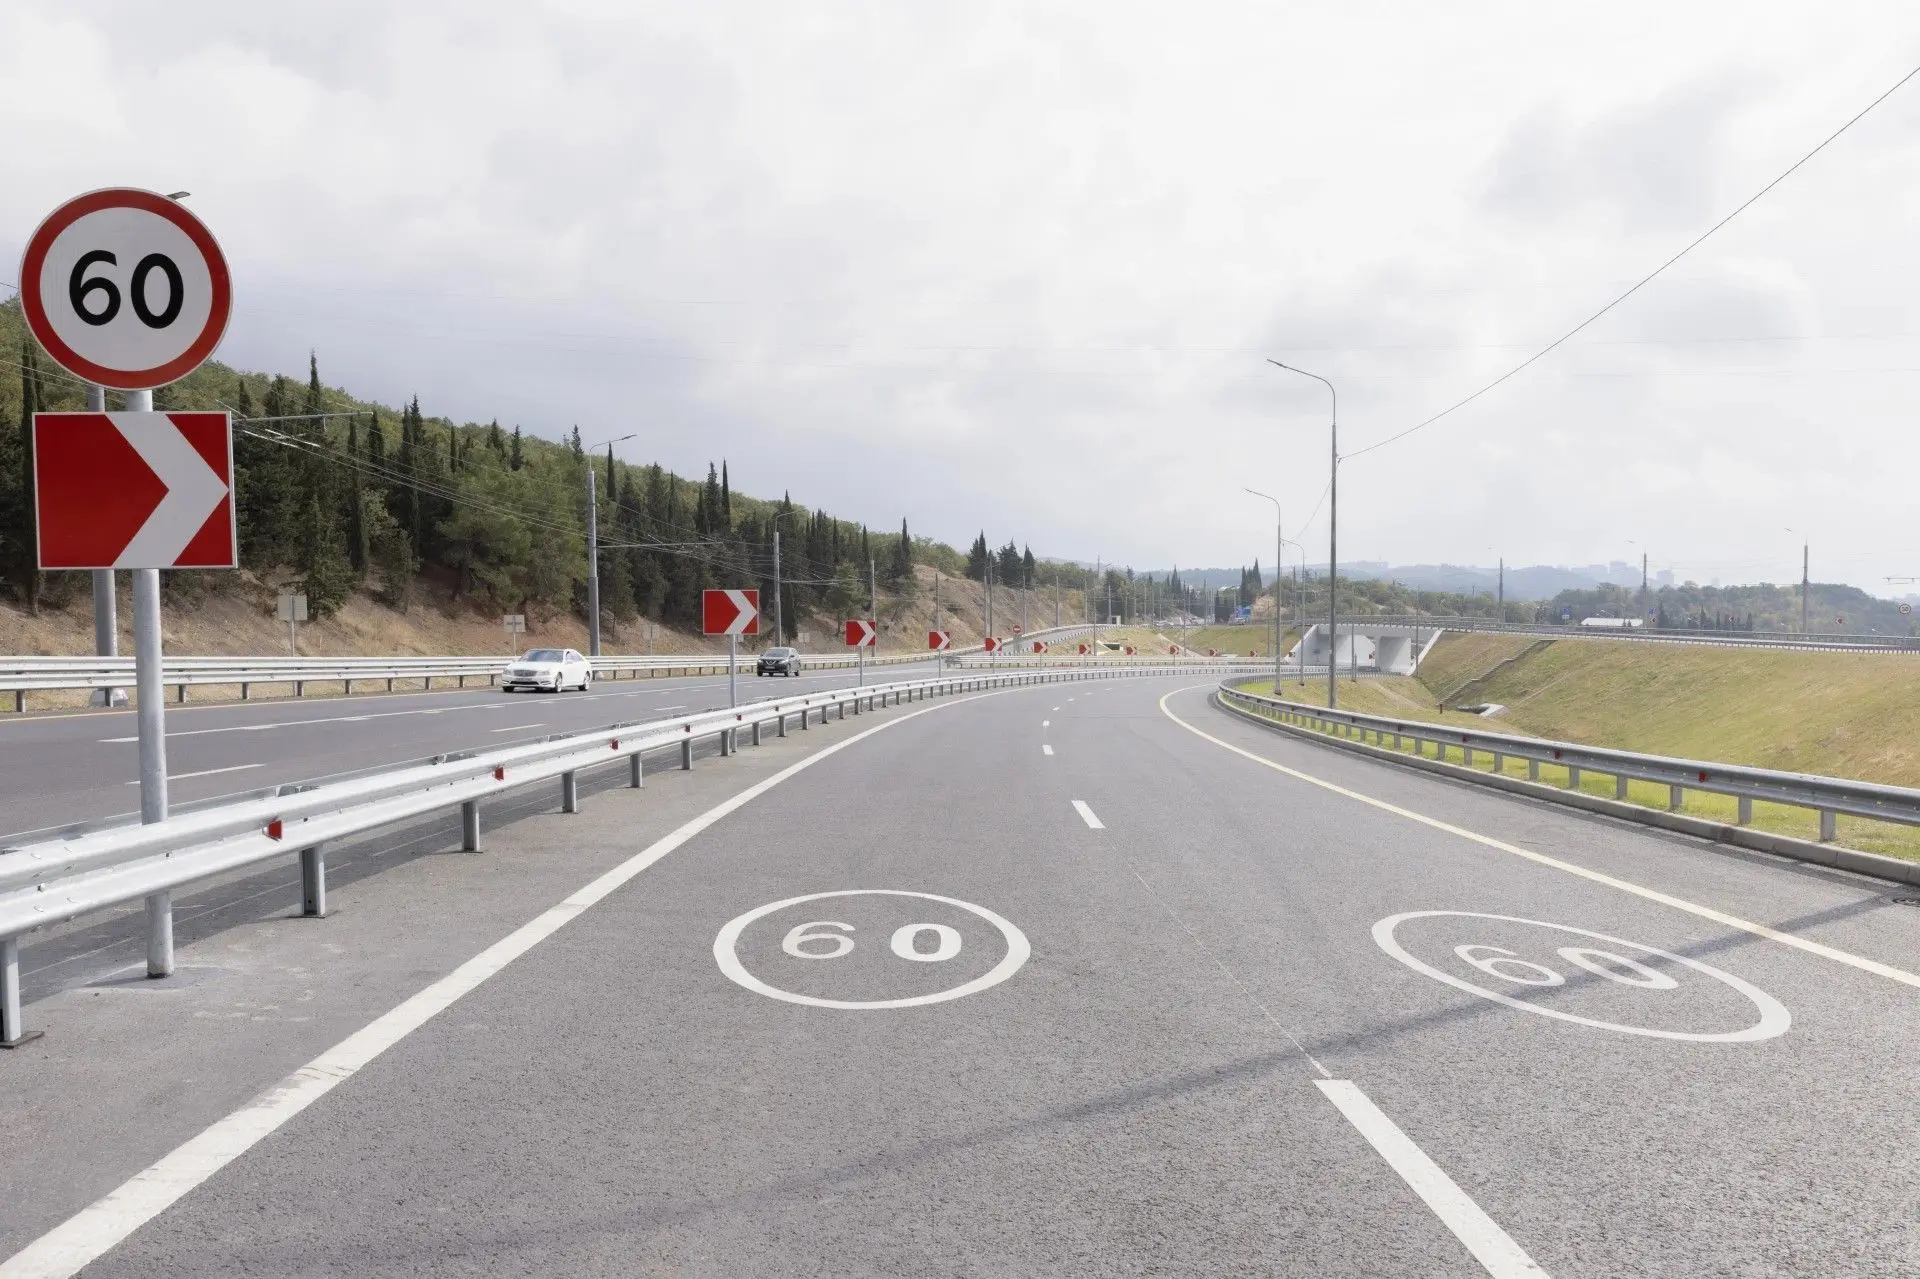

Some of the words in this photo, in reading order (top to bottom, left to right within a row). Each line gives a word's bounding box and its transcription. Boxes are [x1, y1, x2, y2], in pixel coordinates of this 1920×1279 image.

[69, 249, 184, 329] 60
[782, 920, 962, 962] 60
[1453, 944, 1679, 989] 60
